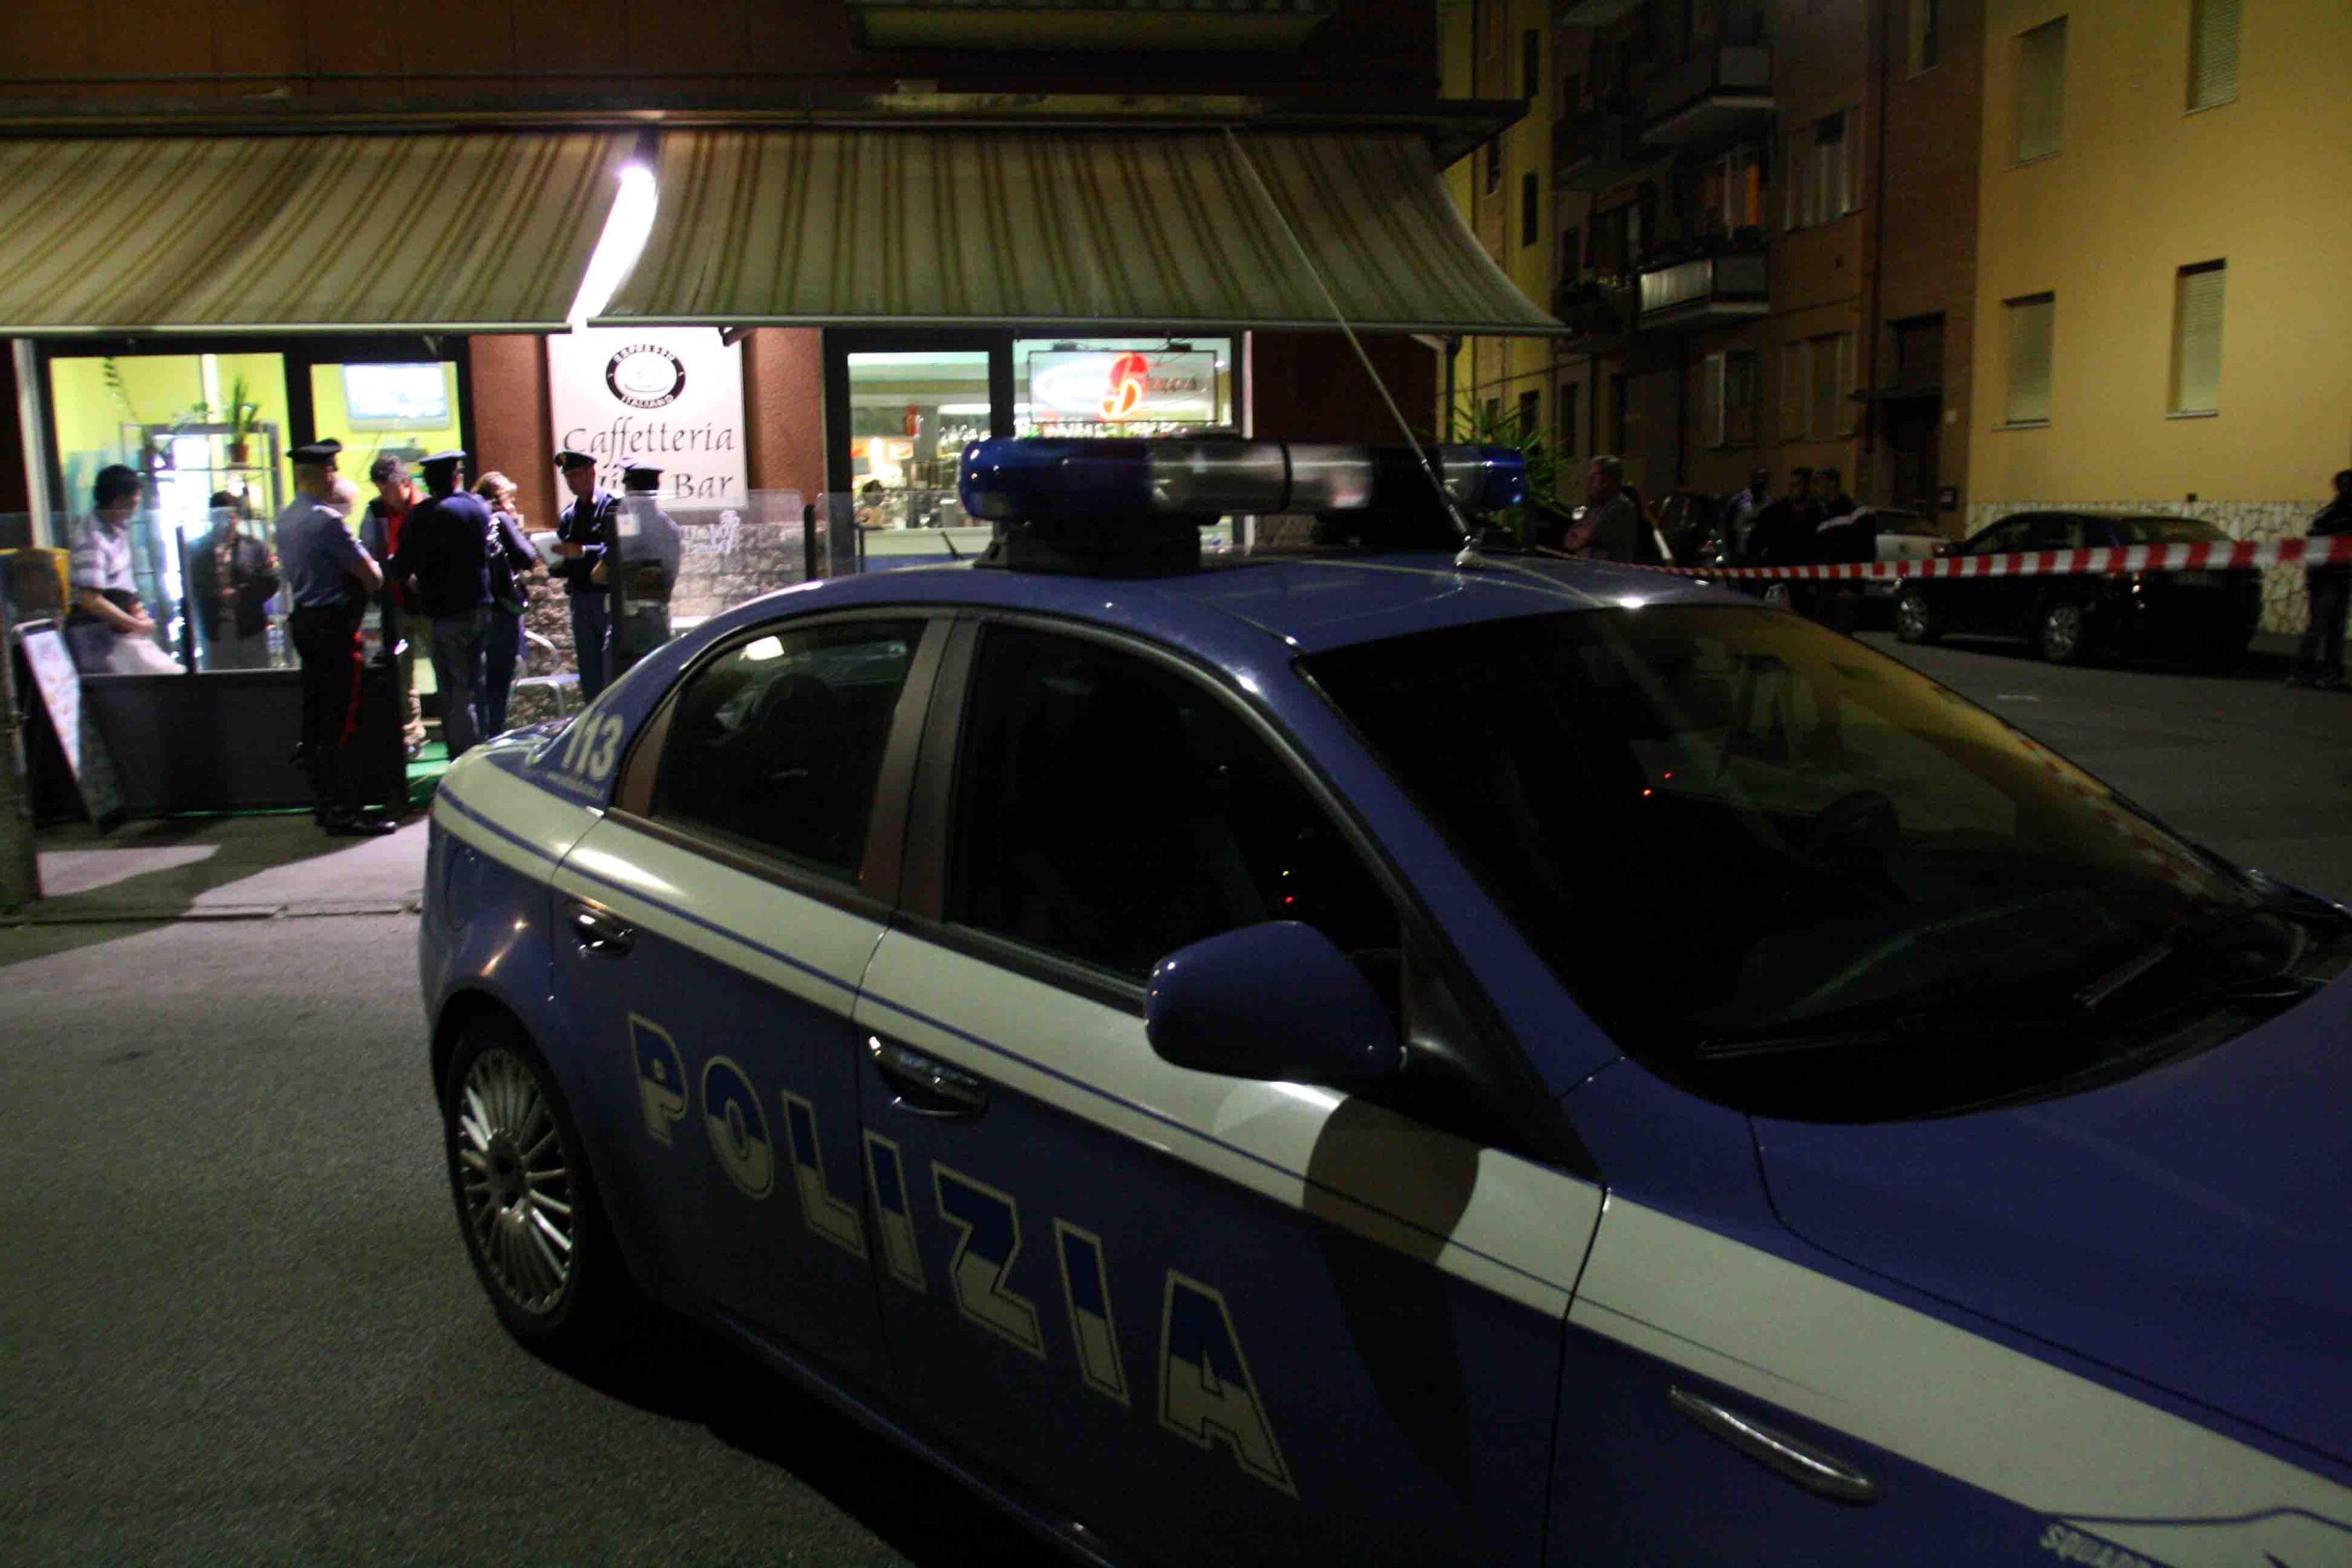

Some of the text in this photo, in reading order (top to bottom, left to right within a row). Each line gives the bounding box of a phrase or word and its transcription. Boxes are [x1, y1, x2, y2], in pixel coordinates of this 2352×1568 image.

[621, 394, 675, 408] ITALIANO
[564, 416, 735, 469] Caffetteria
[671, 473, 734, 499] Bar
[562, 713, 623, 781] 113
[629, 1012, 1298, 1498] POLIZIA
